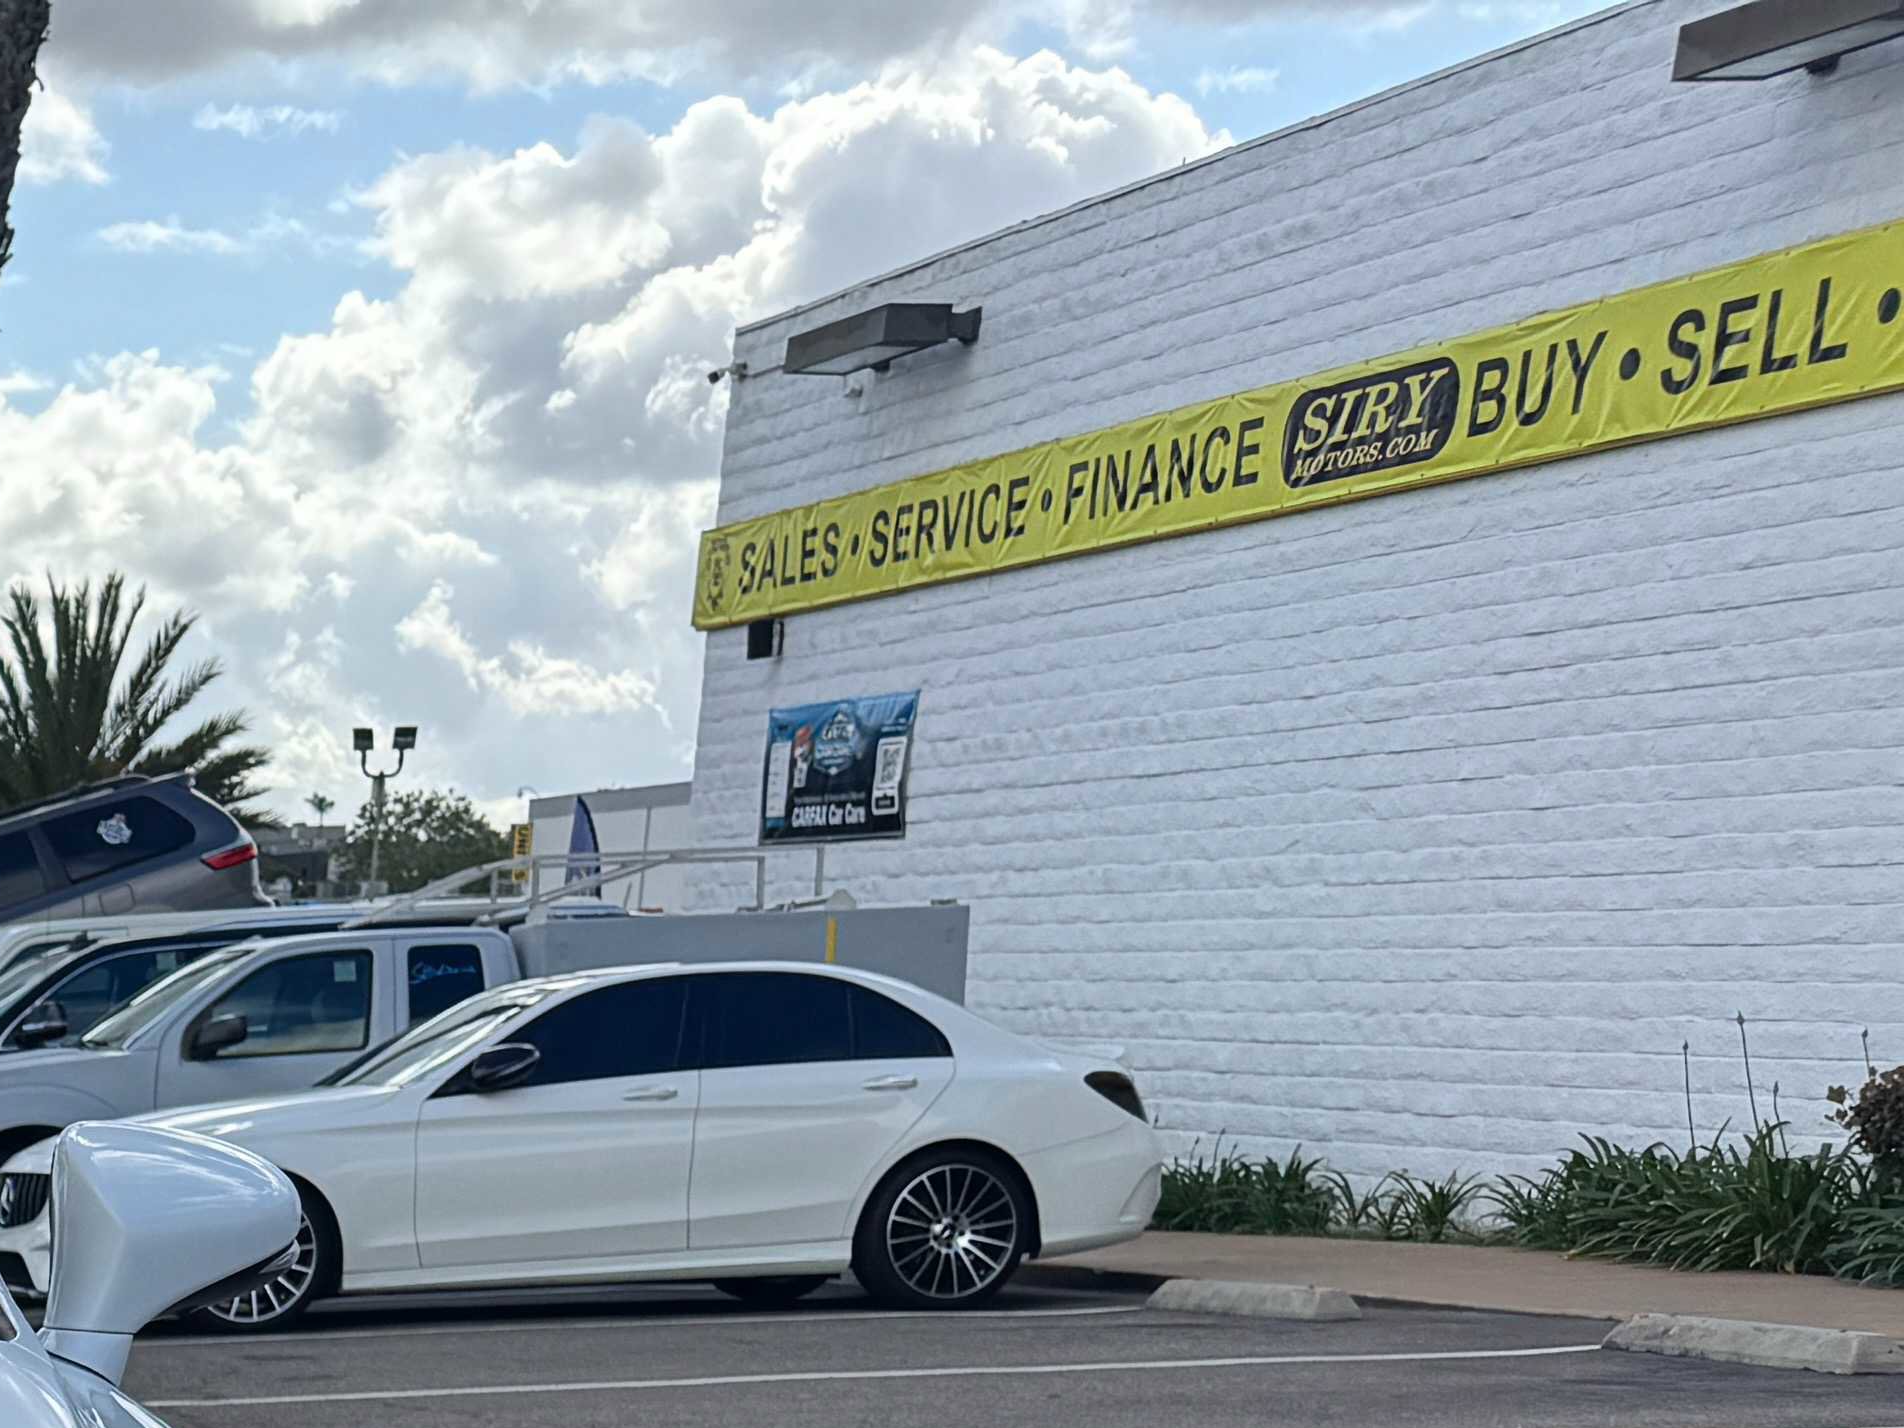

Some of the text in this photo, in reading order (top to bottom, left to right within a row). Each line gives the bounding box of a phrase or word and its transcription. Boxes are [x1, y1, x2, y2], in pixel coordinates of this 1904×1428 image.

[1293, 366, 1451, 455] SIRY
[1467, 276, 1849, 439] BUY SELL
[738, 416, 1265, 594] SALES SERVICE FINANCE
[1291, 429, 1439, 482] MOTORS.COM
